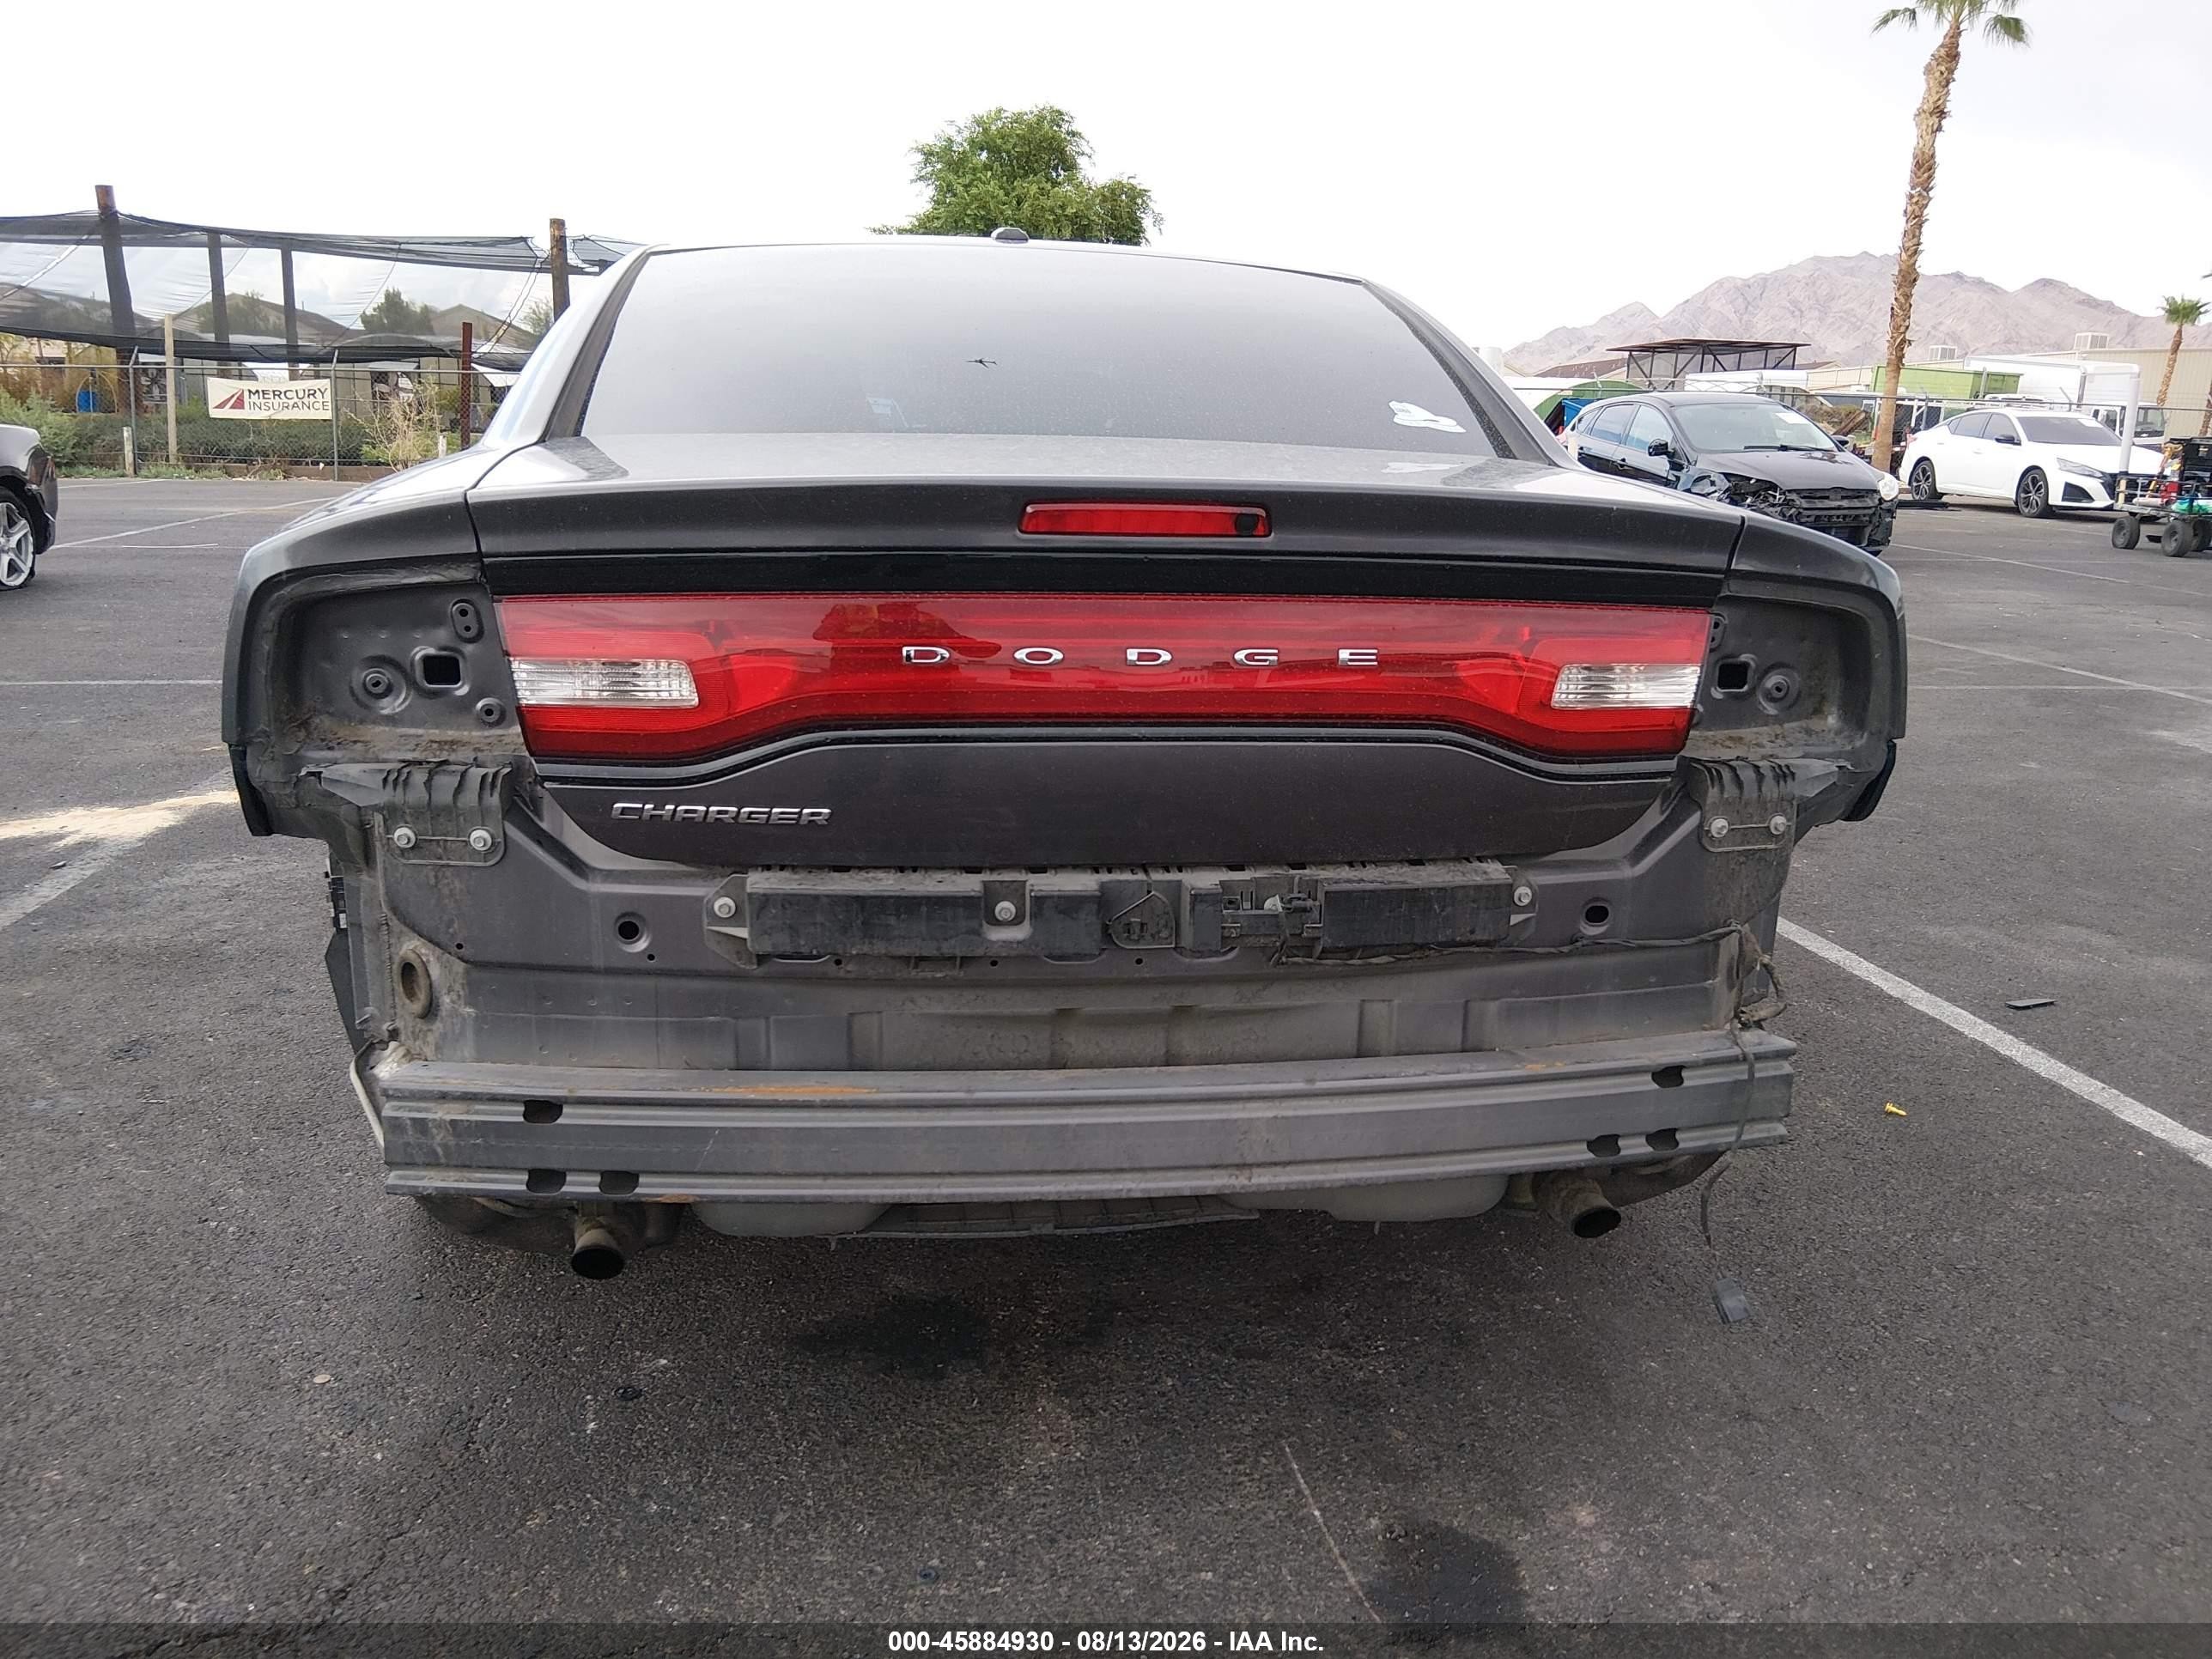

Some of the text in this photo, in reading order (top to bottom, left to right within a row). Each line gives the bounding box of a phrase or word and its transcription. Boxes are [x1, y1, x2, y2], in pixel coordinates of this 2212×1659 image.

[247, 387, 328, 400] MERCURY
[248, 400, 330, 411] INSURANCE
[902, 646, 1379, 666] DODGE
[611, 802, 832, 825] CHARGER
